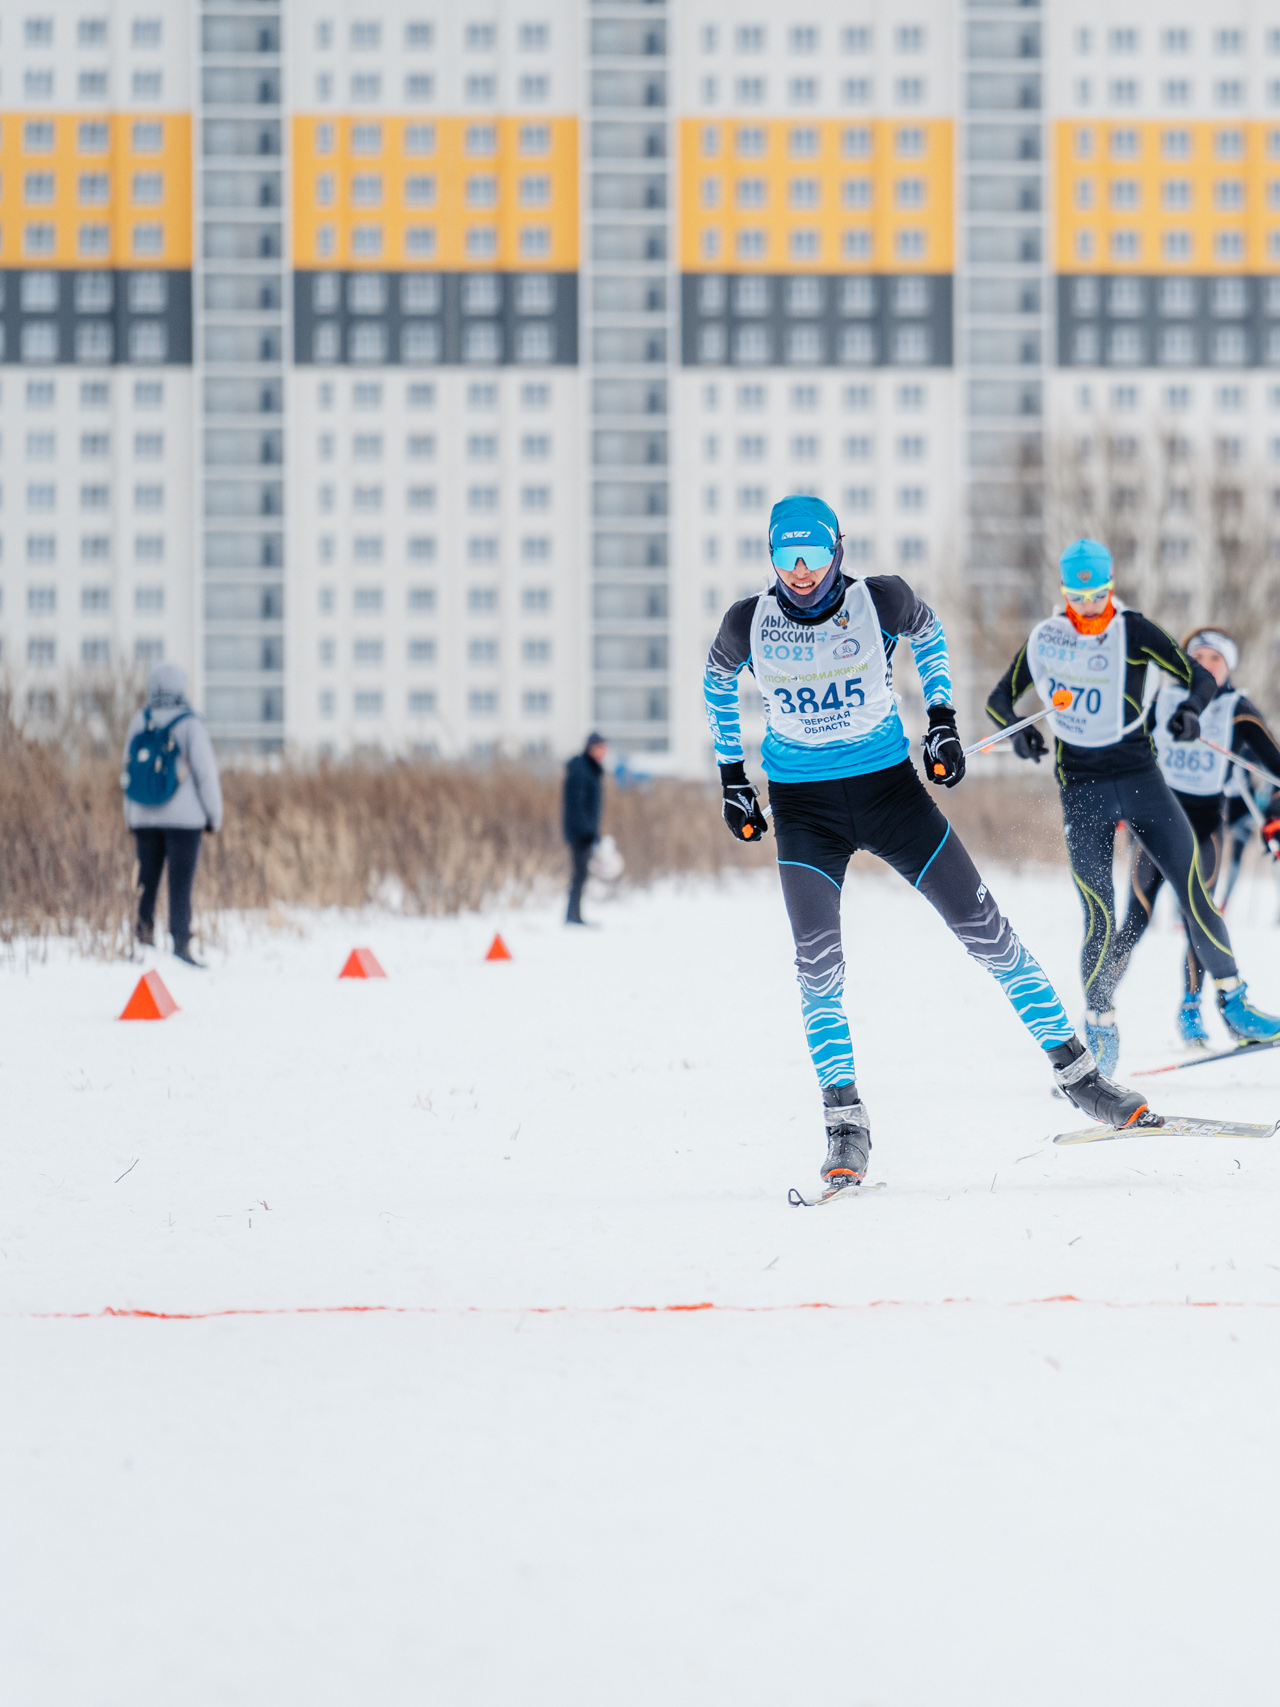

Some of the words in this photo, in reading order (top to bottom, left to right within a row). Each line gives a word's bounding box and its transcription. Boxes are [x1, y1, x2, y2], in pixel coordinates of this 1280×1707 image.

[760, 615, 814, 630] ЛЫЖ
[761, 629, 815, 643] РОССИИ
[763, 644, 814, 661] 2023
[764, 674, 791, 684] СПОРТ
[798, 671, 833, 683] НОРМА
[774, 677, 865, 714] 3845
[798, 710, 851, 727] ТВЕРСКАЯ
[804, 720, 851, 734] ОБЛАСТЬ
[1165, 747, 1215, 773] 2863
